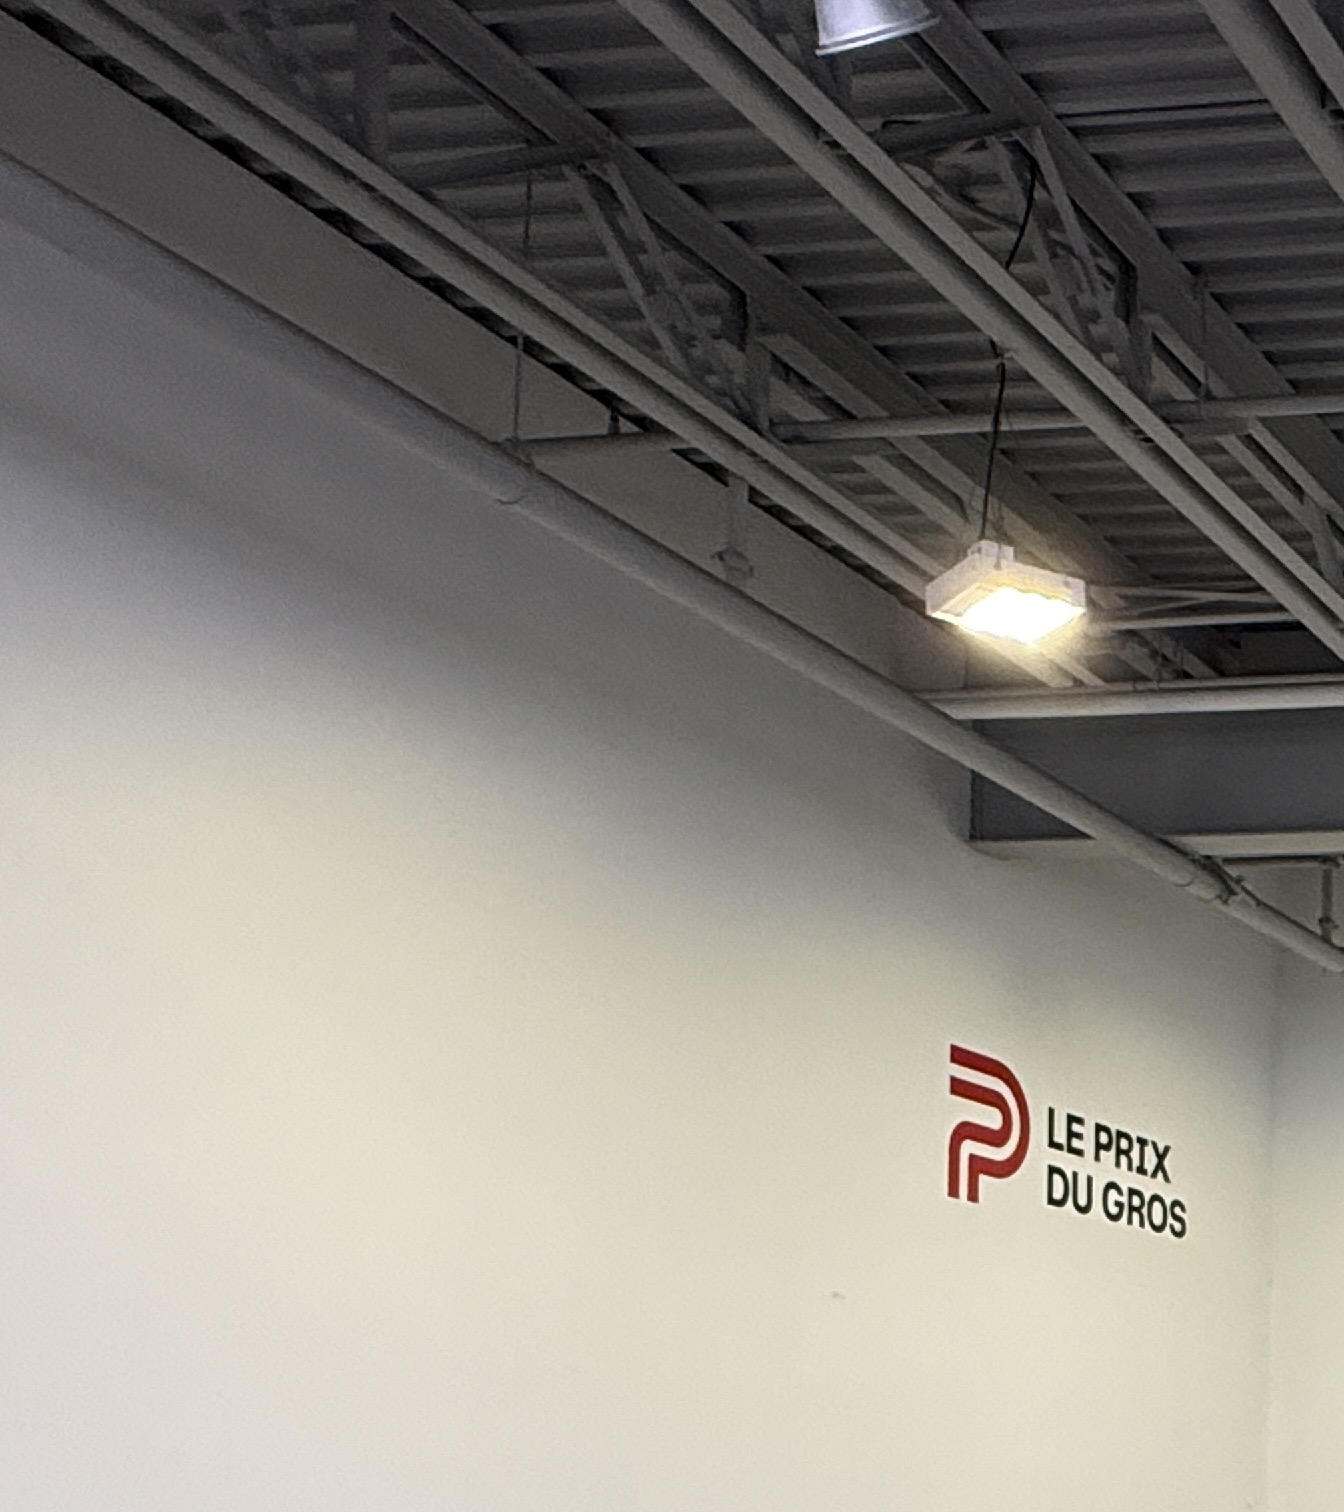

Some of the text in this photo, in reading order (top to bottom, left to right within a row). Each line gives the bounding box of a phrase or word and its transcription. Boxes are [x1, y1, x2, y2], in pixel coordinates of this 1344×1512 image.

[1047, 1106, 1172, 1184] LE PRIX
[1046, 1164, 1187, 1239] DU GROS
